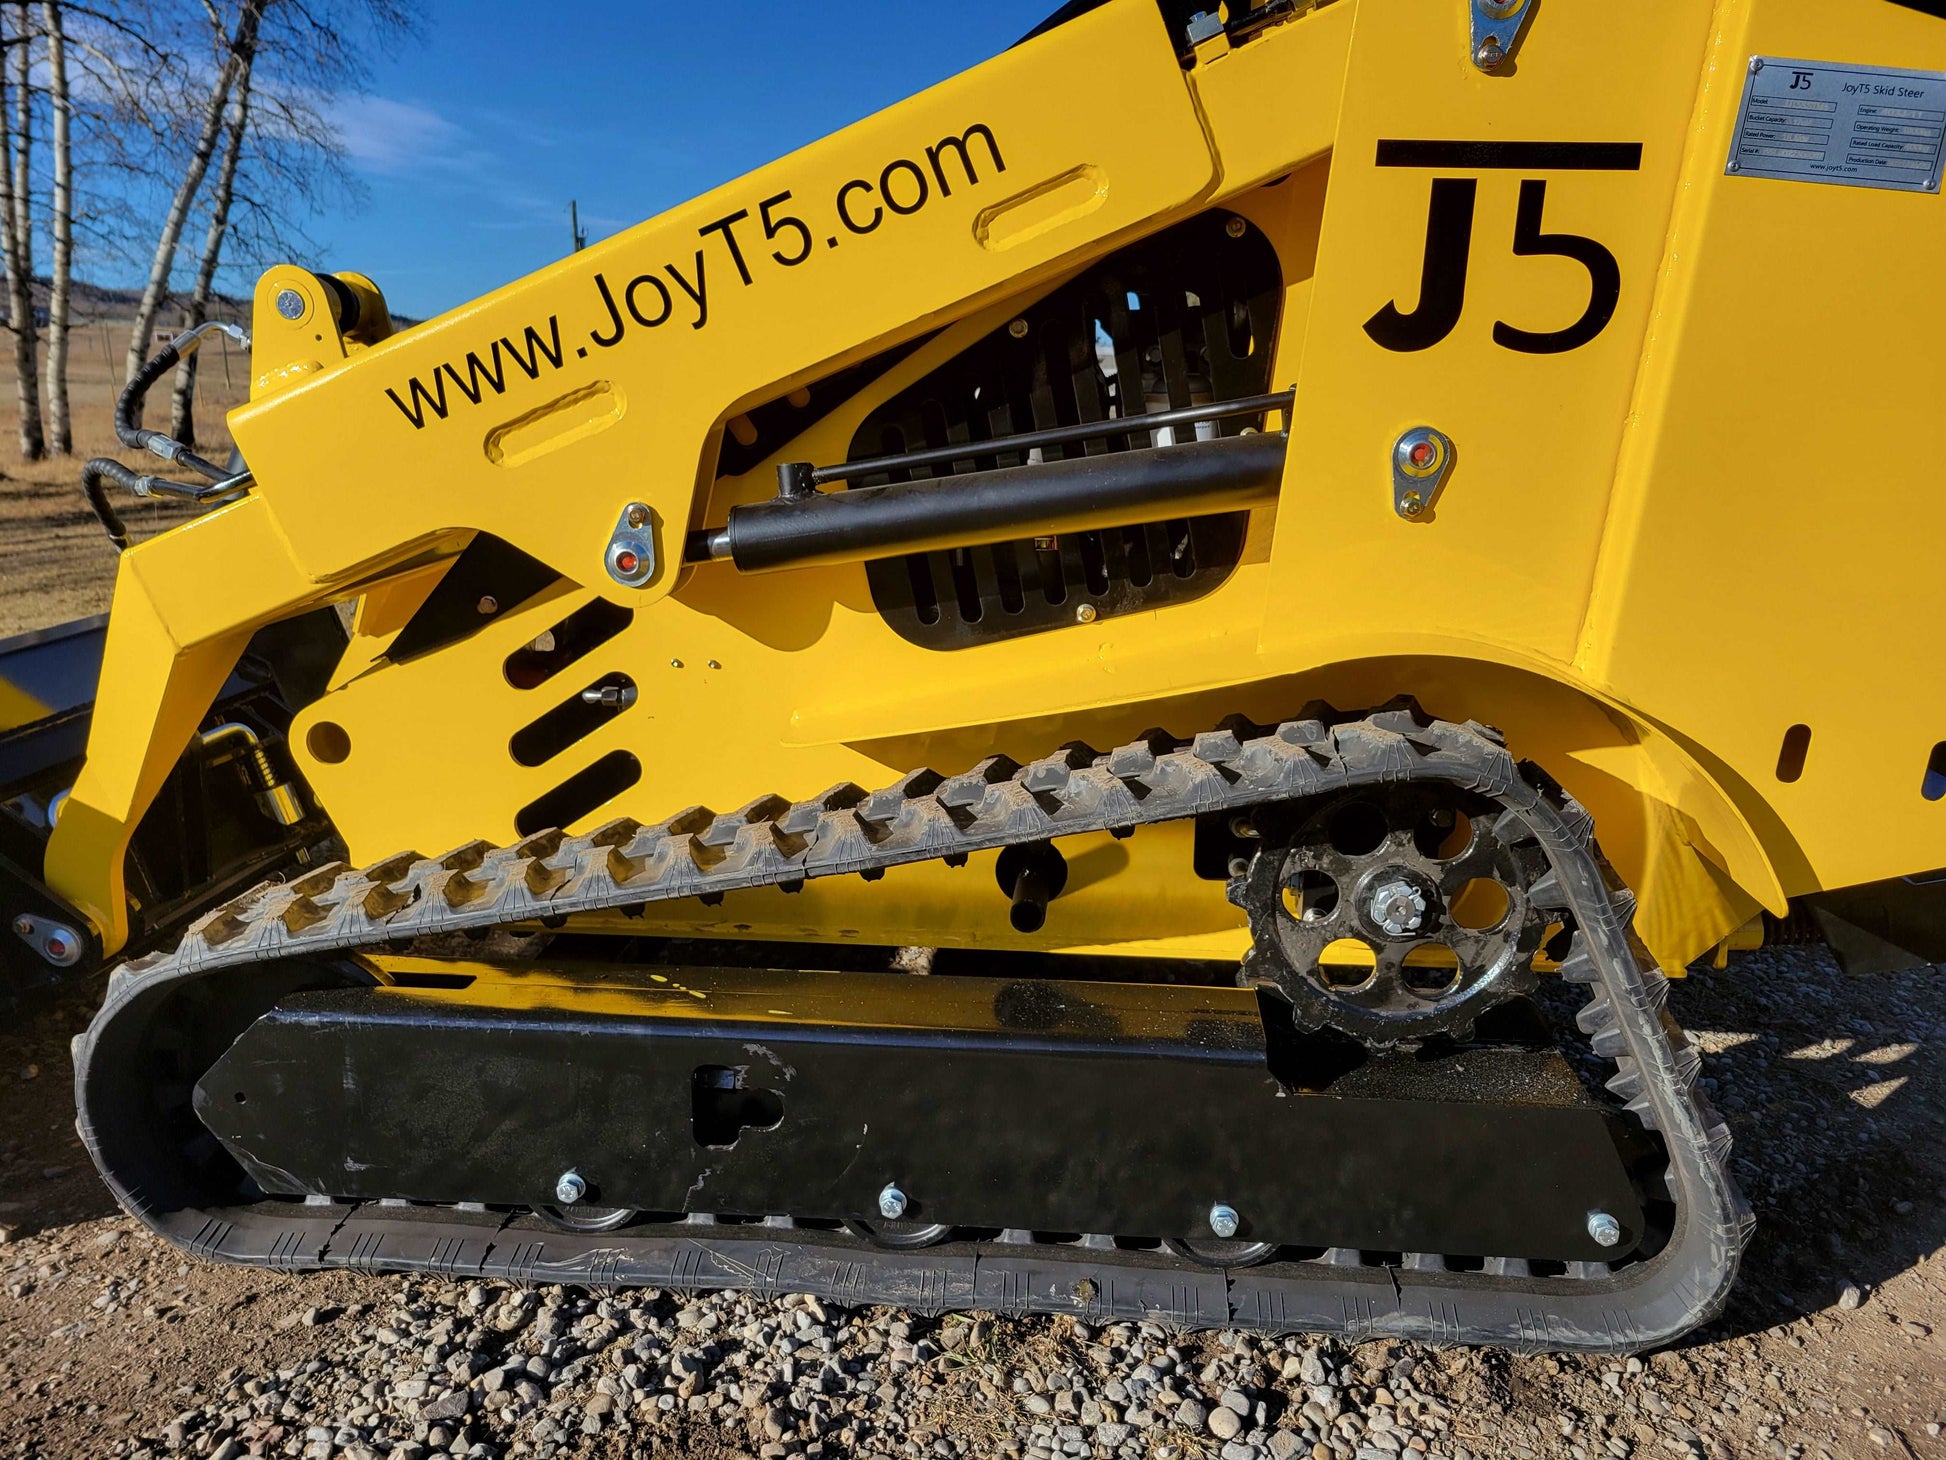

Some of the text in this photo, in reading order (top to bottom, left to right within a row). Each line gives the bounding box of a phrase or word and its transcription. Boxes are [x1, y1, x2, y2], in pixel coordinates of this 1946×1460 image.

[1789, 74, 1812, 90] J5
[1841, 82, 1925, 98] JoyT5 Skid Steer
[1856, 124, 1880, 132] Operating
[1809, 163, 1858, 173] www.joyt5.com
[1848, 156, 1874, 164] Production
[1361, 177, 1622, 355] J5
[384, 123, 1006, 429] www.JoyT5.com
